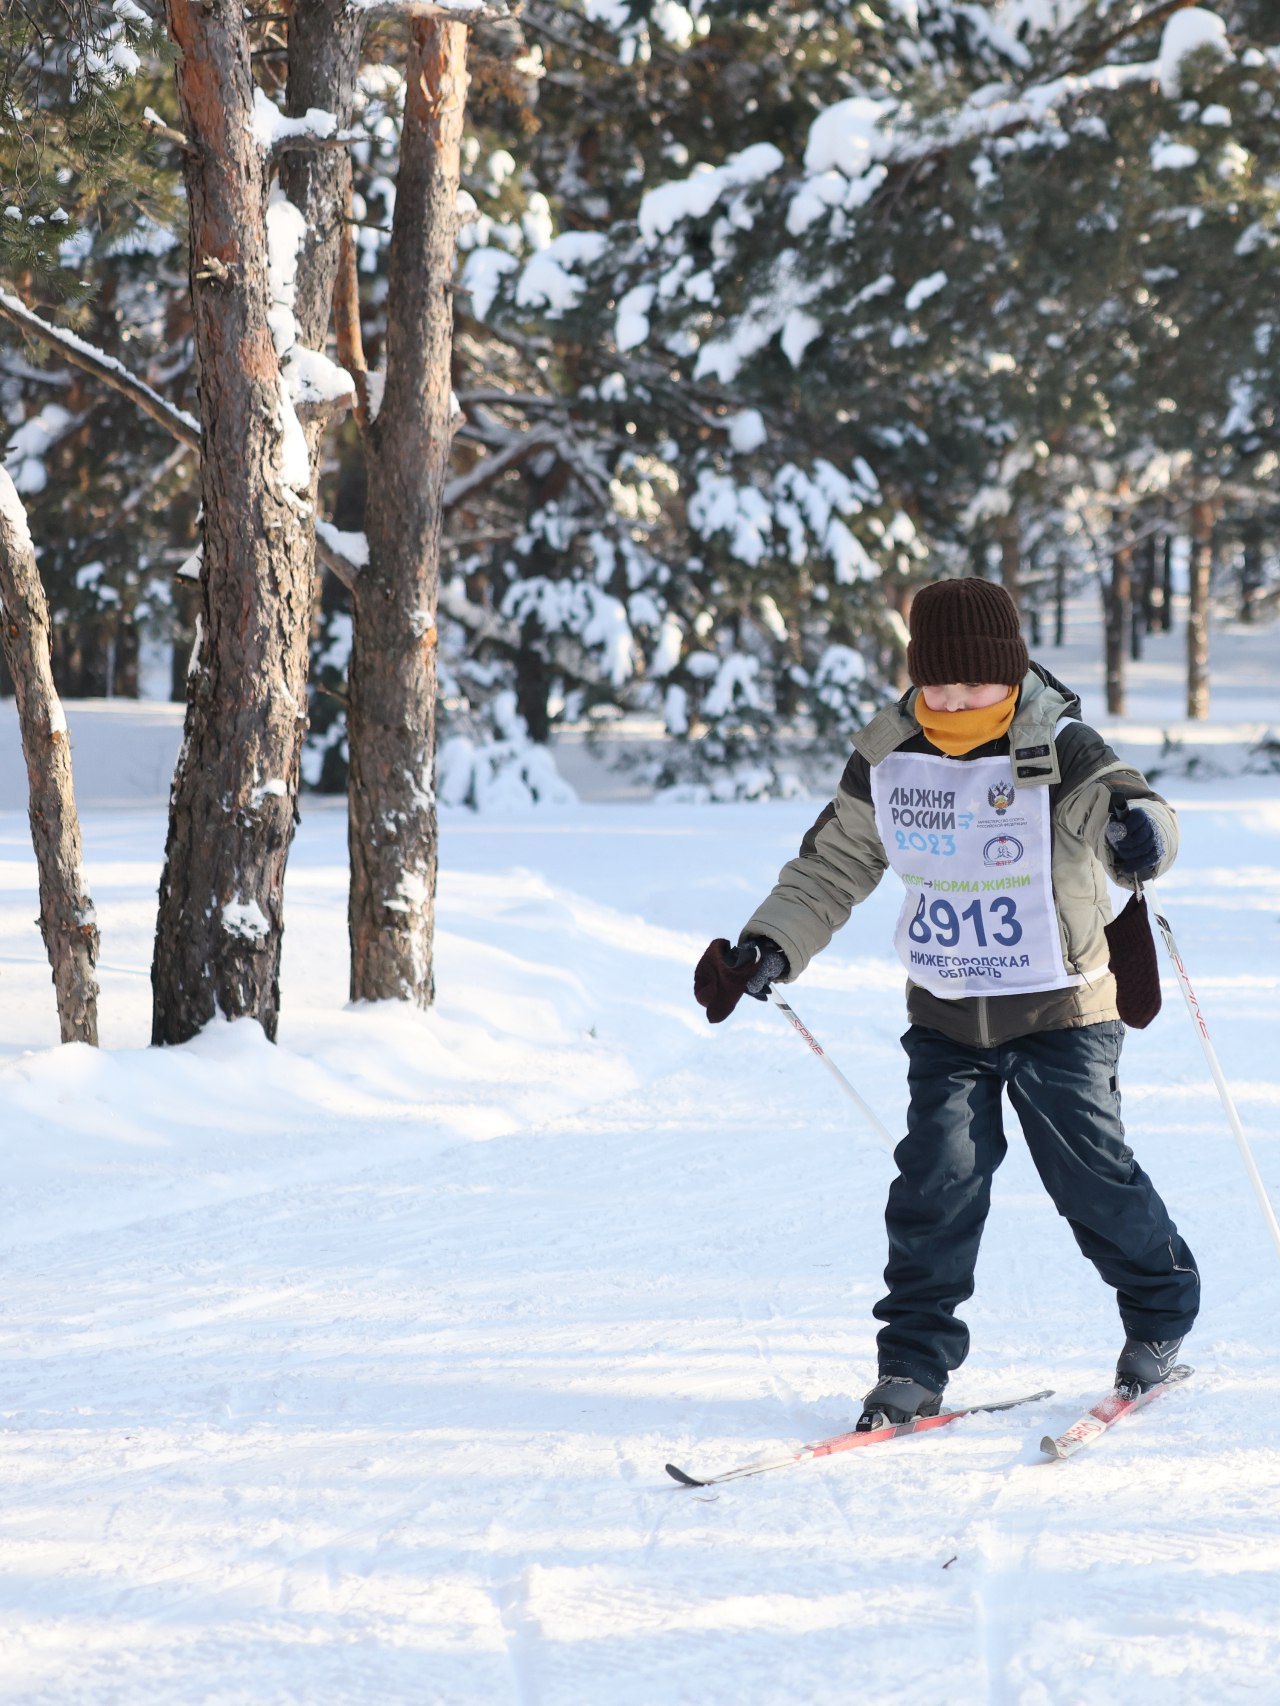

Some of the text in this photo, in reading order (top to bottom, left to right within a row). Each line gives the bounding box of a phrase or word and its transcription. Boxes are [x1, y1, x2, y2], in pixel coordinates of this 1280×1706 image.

[888, 787, 956, 810] ЛЫЖНЯ
[891, 807, 956, 830] РОССИИ
[895, 829, 957, 856] 2023
[934, 878, 979, 892] НОРМА
[982, 873, 1031, 891] ЖИЗНИ
[908, 892, 1023, 948] 8913
[910, 950, 1030, 968] НИЖЕГОРОДСКАЯ
[938, 966, 1002, 979] ОБЛАСТЬ
[793, 1019, 825, 1056] SPINE
